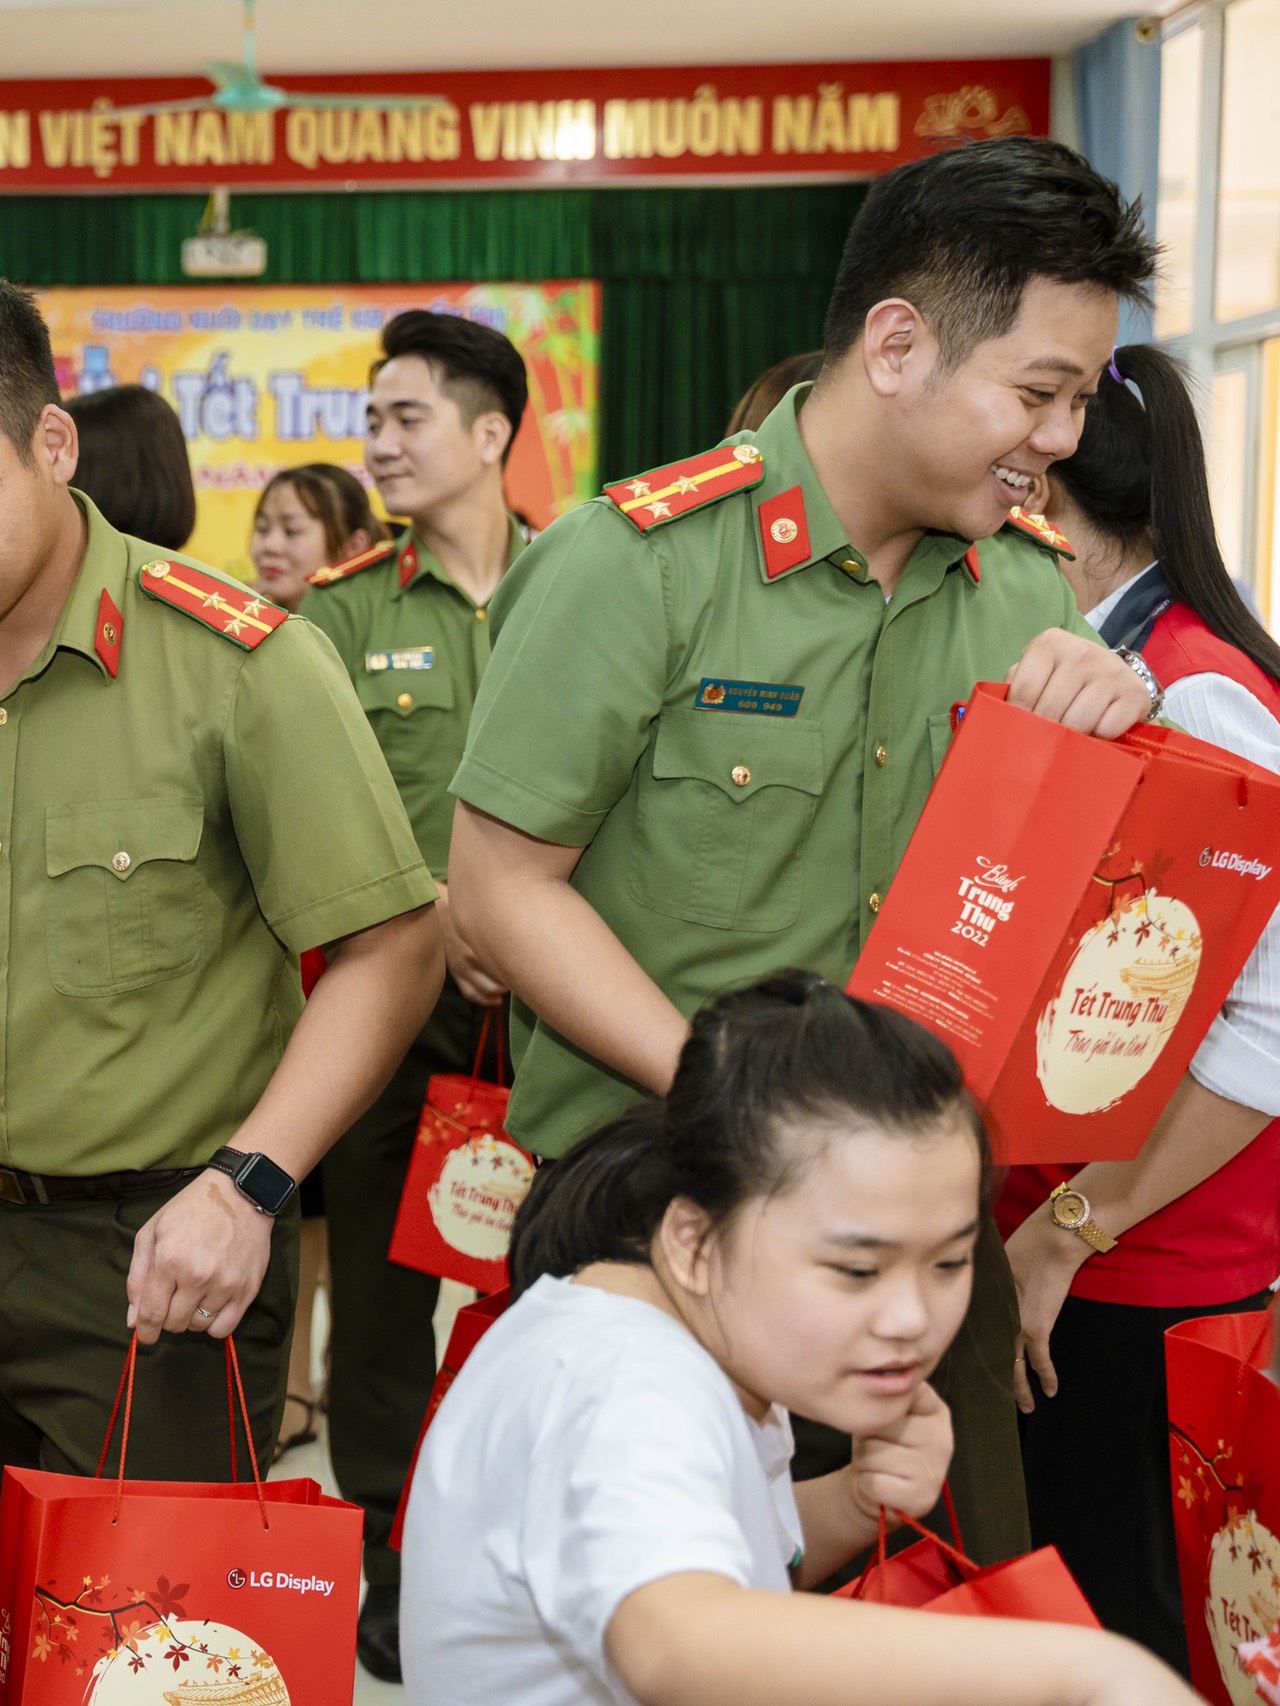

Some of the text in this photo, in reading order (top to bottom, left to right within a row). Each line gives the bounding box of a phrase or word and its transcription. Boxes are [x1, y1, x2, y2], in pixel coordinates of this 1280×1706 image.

[38, 96, 142, 178] VIỆT
[154, 106, 274, 166] NAM
[285, 103, 460, 169] QUANG
[468, 99, 597, 161] VINH
[603, 83, 766, 160] MUÔN
[772, 82, 901, 155] NĂM
[174, 350, 256, 440] Tết
[270, 373, 372, 440] Tru
[976, 856, 1026, 892] Bánh
[1211, 850, 1273, 881] LG Display
[957, 876, 1015, 921] Trung
[960, 900, 996, 933] Thu
[950, 921, 989, 947] 2022
[1070, 982, 1168, 1028] Tết Trung Thu
[469, 1186, 499, 1211] Trung
[250, 1571, 273, 1588] LG
[276, 1572, 335, 1597] Display
